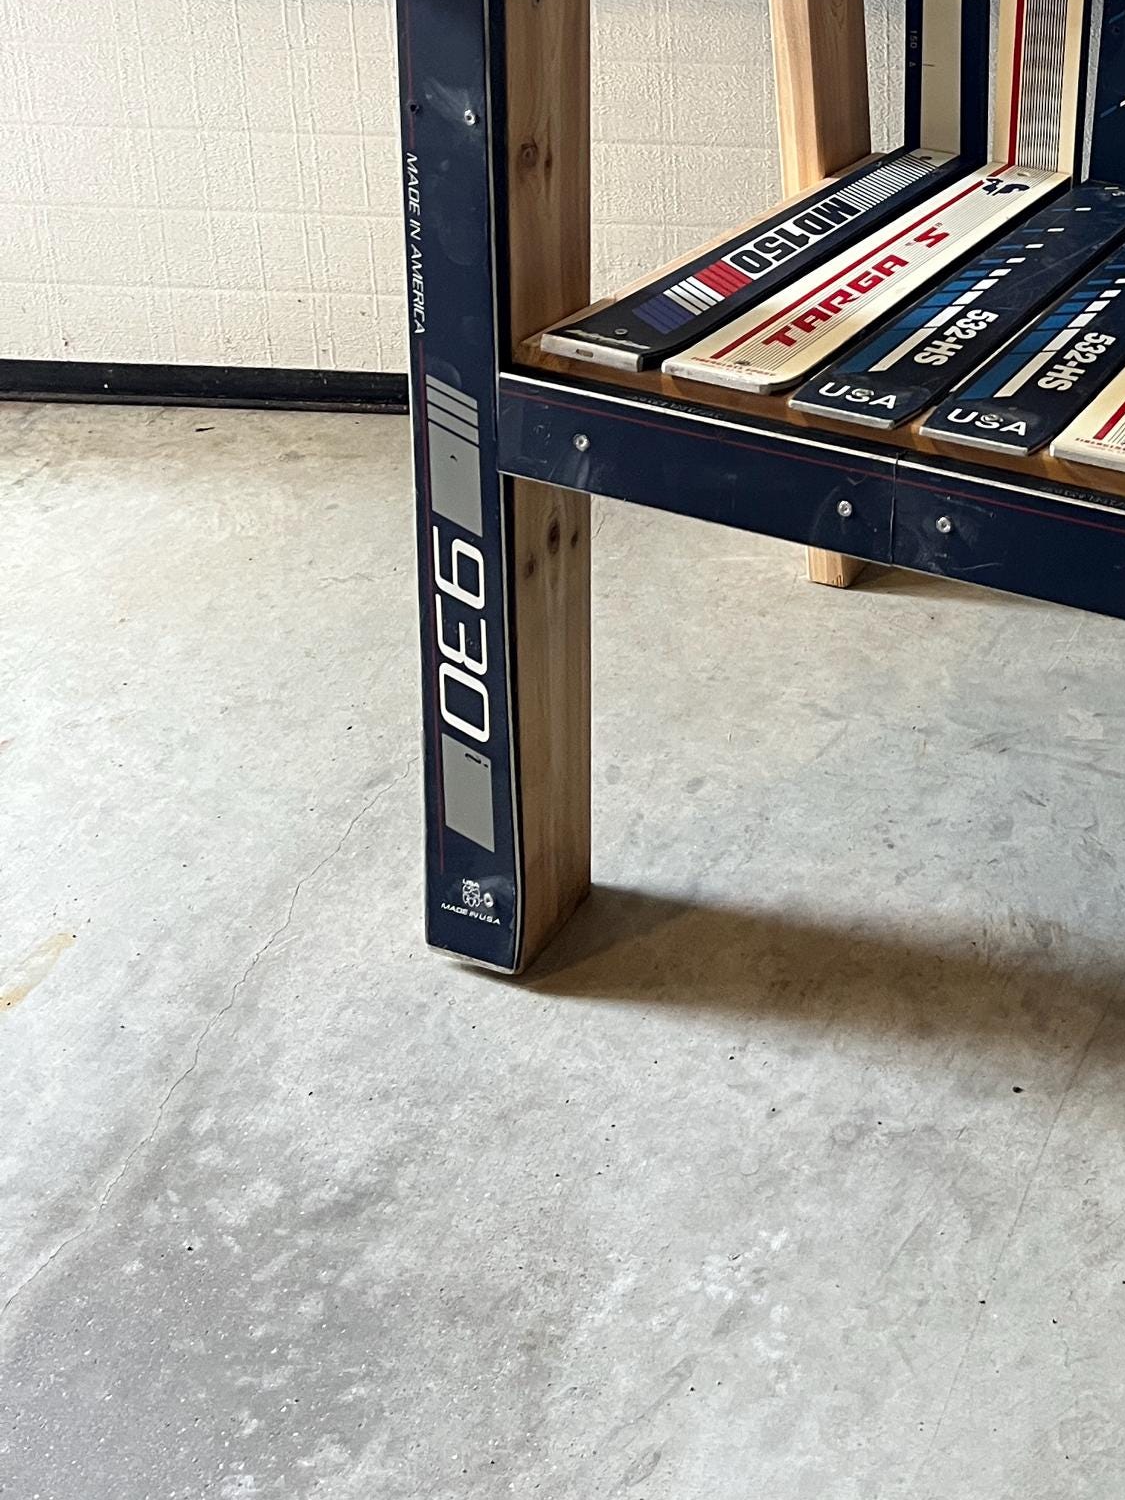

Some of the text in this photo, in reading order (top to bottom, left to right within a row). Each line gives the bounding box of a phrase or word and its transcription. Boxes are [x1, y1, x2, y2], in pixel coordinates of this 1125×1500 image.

[406, 152, 426, 334] MADE IN AMERICA
[730, 197, 863, 275] MD150
[761, 254, 909, 347] TARGA
[914, 309, 999, 366] 532-HS
[1038, 332, 1116, 391] 532-HS
[818, 381, 897, 410] USA
[947, 408, 1028, 437] USA
[431, 524, 491, 744] 930
[441, 902, 501, 925] MADE IN USA
